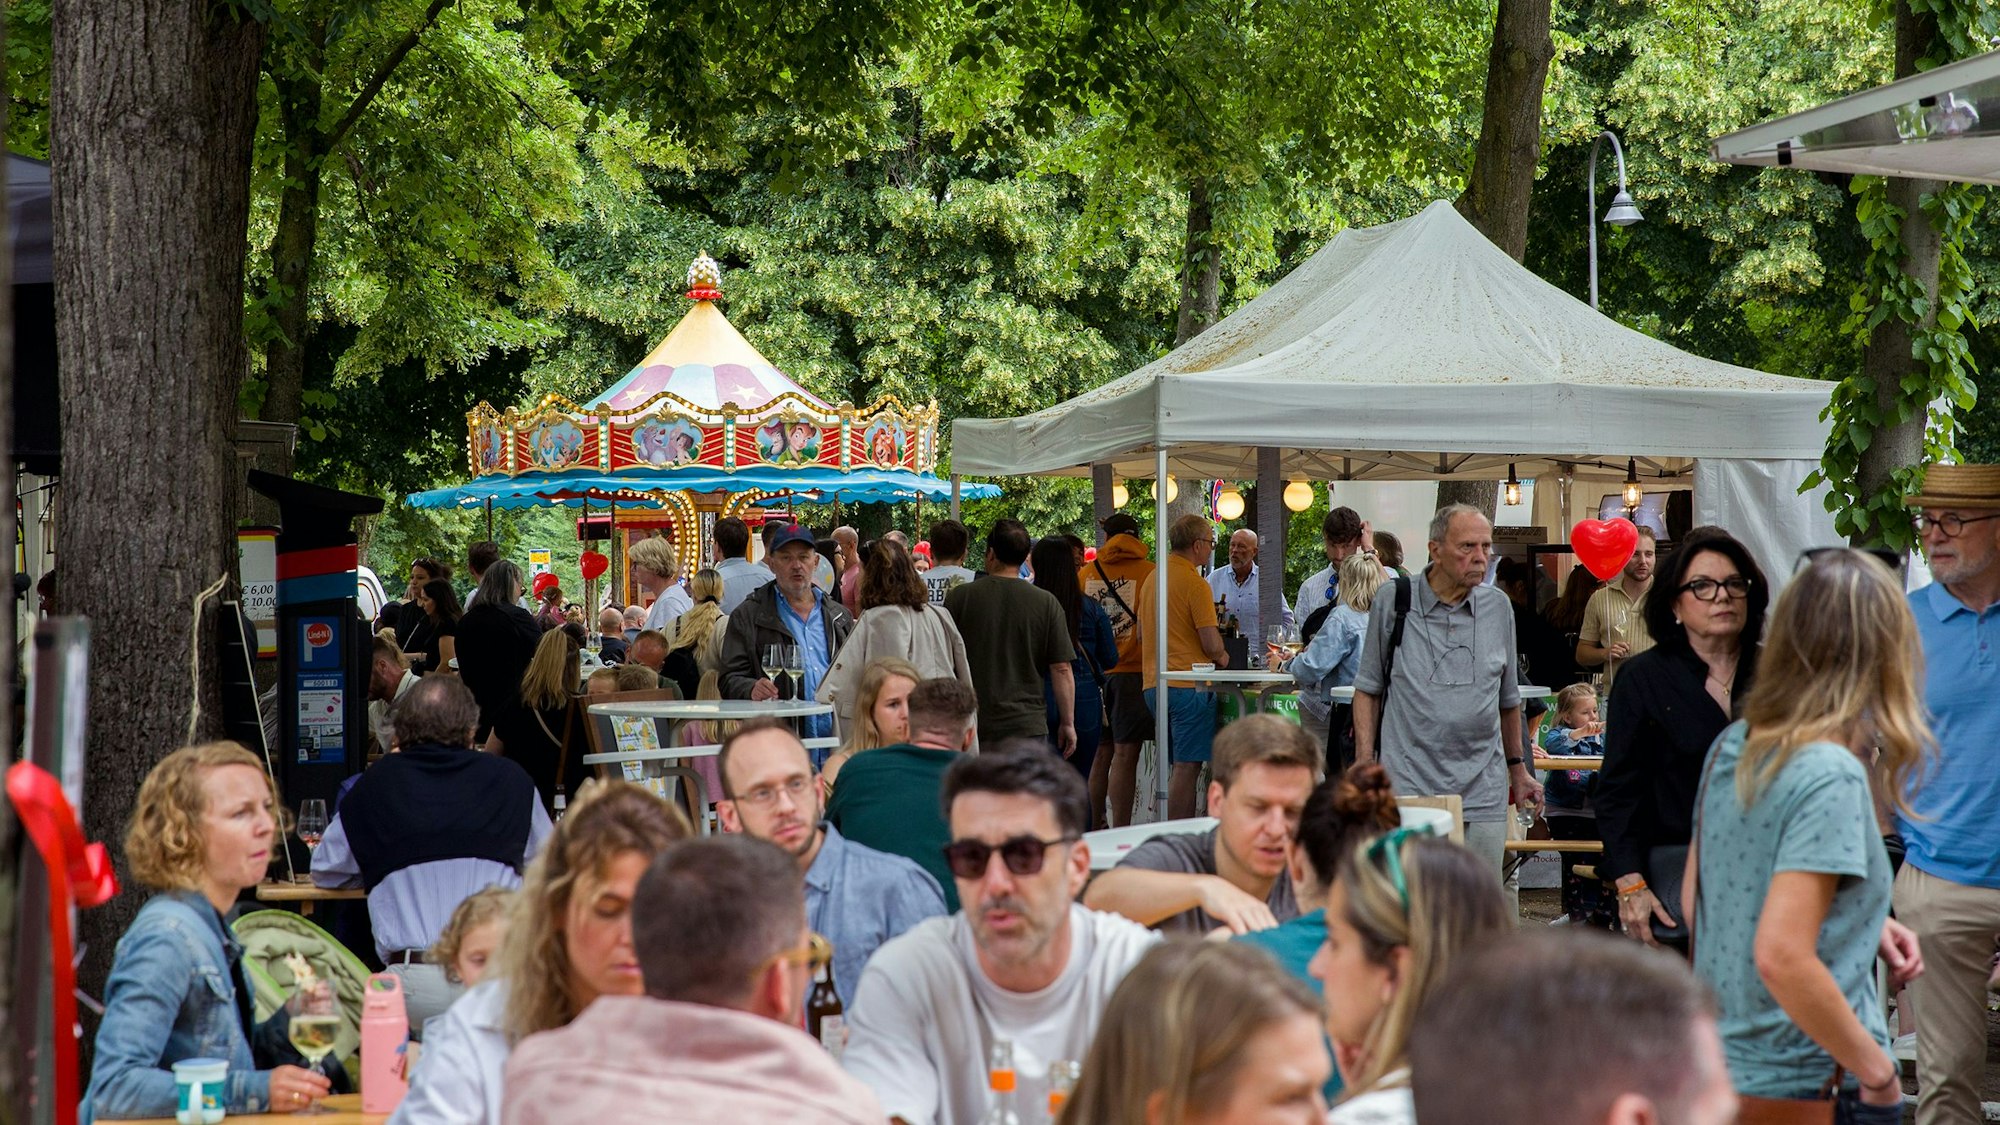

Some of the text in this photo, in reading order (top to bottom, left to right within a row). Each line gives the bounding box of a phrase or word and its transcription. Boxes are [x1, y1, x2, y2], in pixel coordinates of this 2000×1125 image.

[242, 584, 273, 595] € 6,00
[242, 597, 249, 607] €
